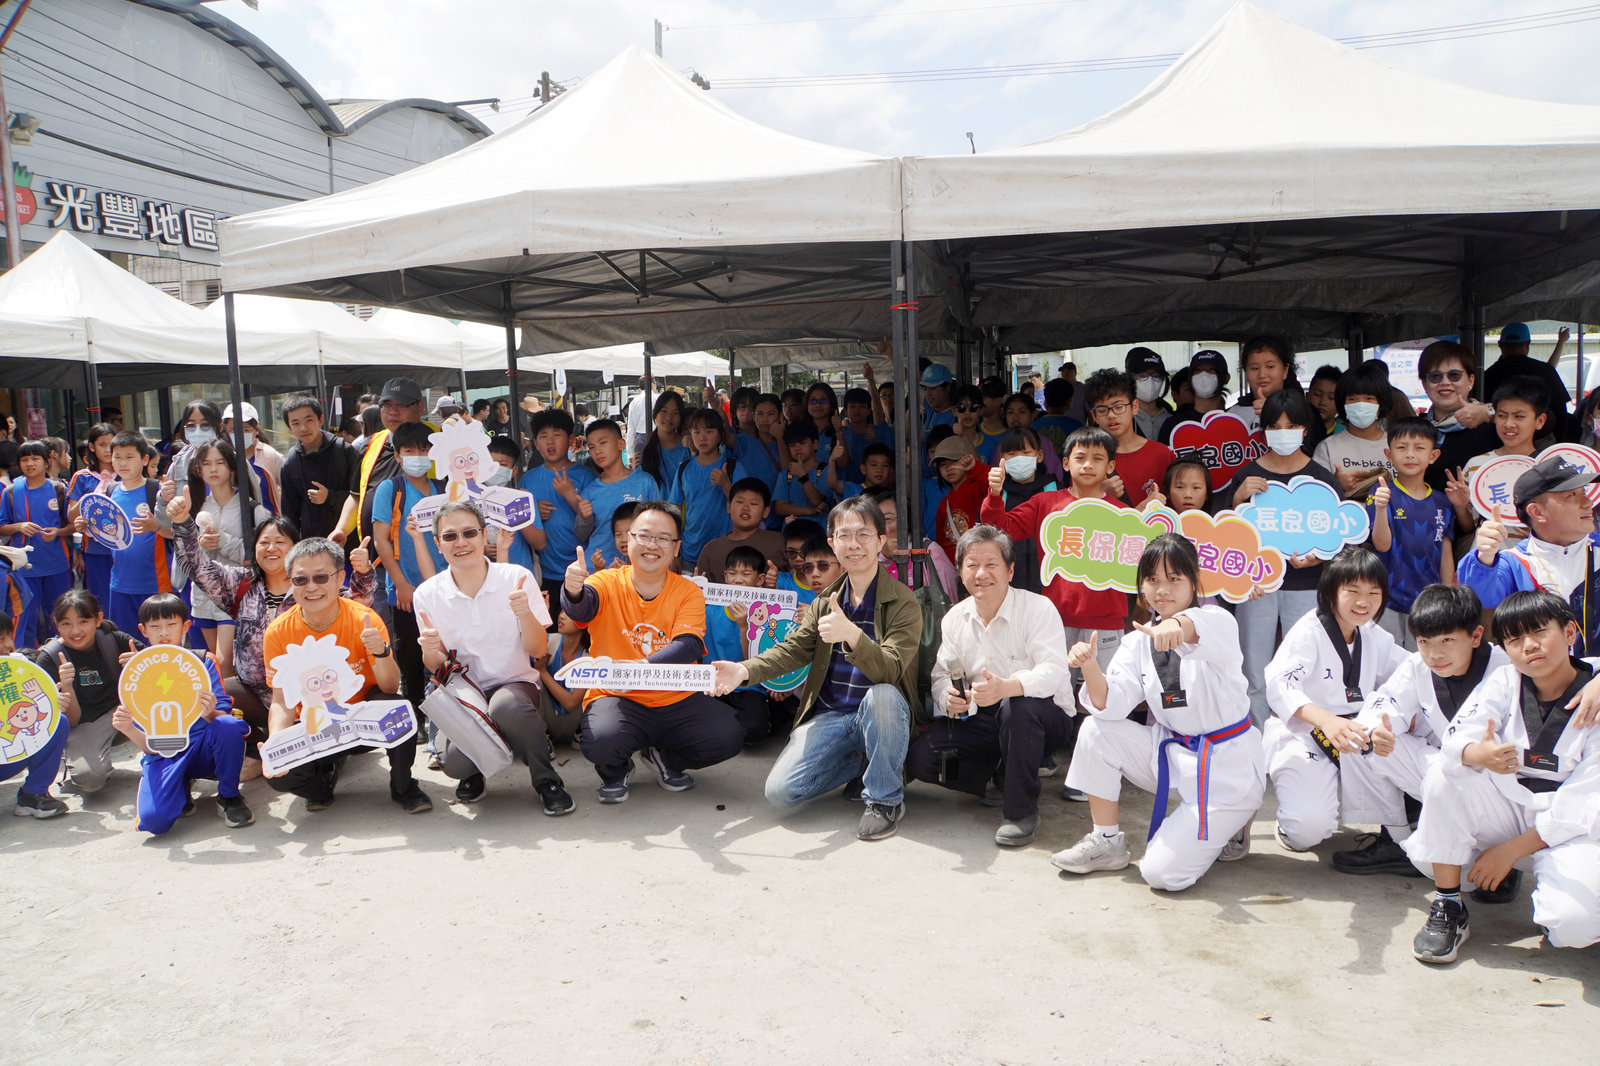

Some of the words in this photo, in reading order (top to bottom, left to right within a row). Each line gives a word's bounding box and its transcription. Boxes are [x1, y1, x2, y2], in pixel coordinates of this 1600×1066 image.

[46, 182, 220, 251] 光豐地區
[93, 496, 115, 511] Agora
[1255, 507, 1357, 535] 長良國小
[1434, 509, 1446, 542] 長良
[1057, 525, 1147, 566] 長保優
[1189, 537, 1273, 583] 良國小
[707, 587, 794, 604] 國家科學及技術委員會
[124, 653, 170, 692] Science
[171, 653, 203, 691] Agora
[570, 668, 609, 678] NSTC
[612, 669, 712, 681] 國家科學及技術委員會
